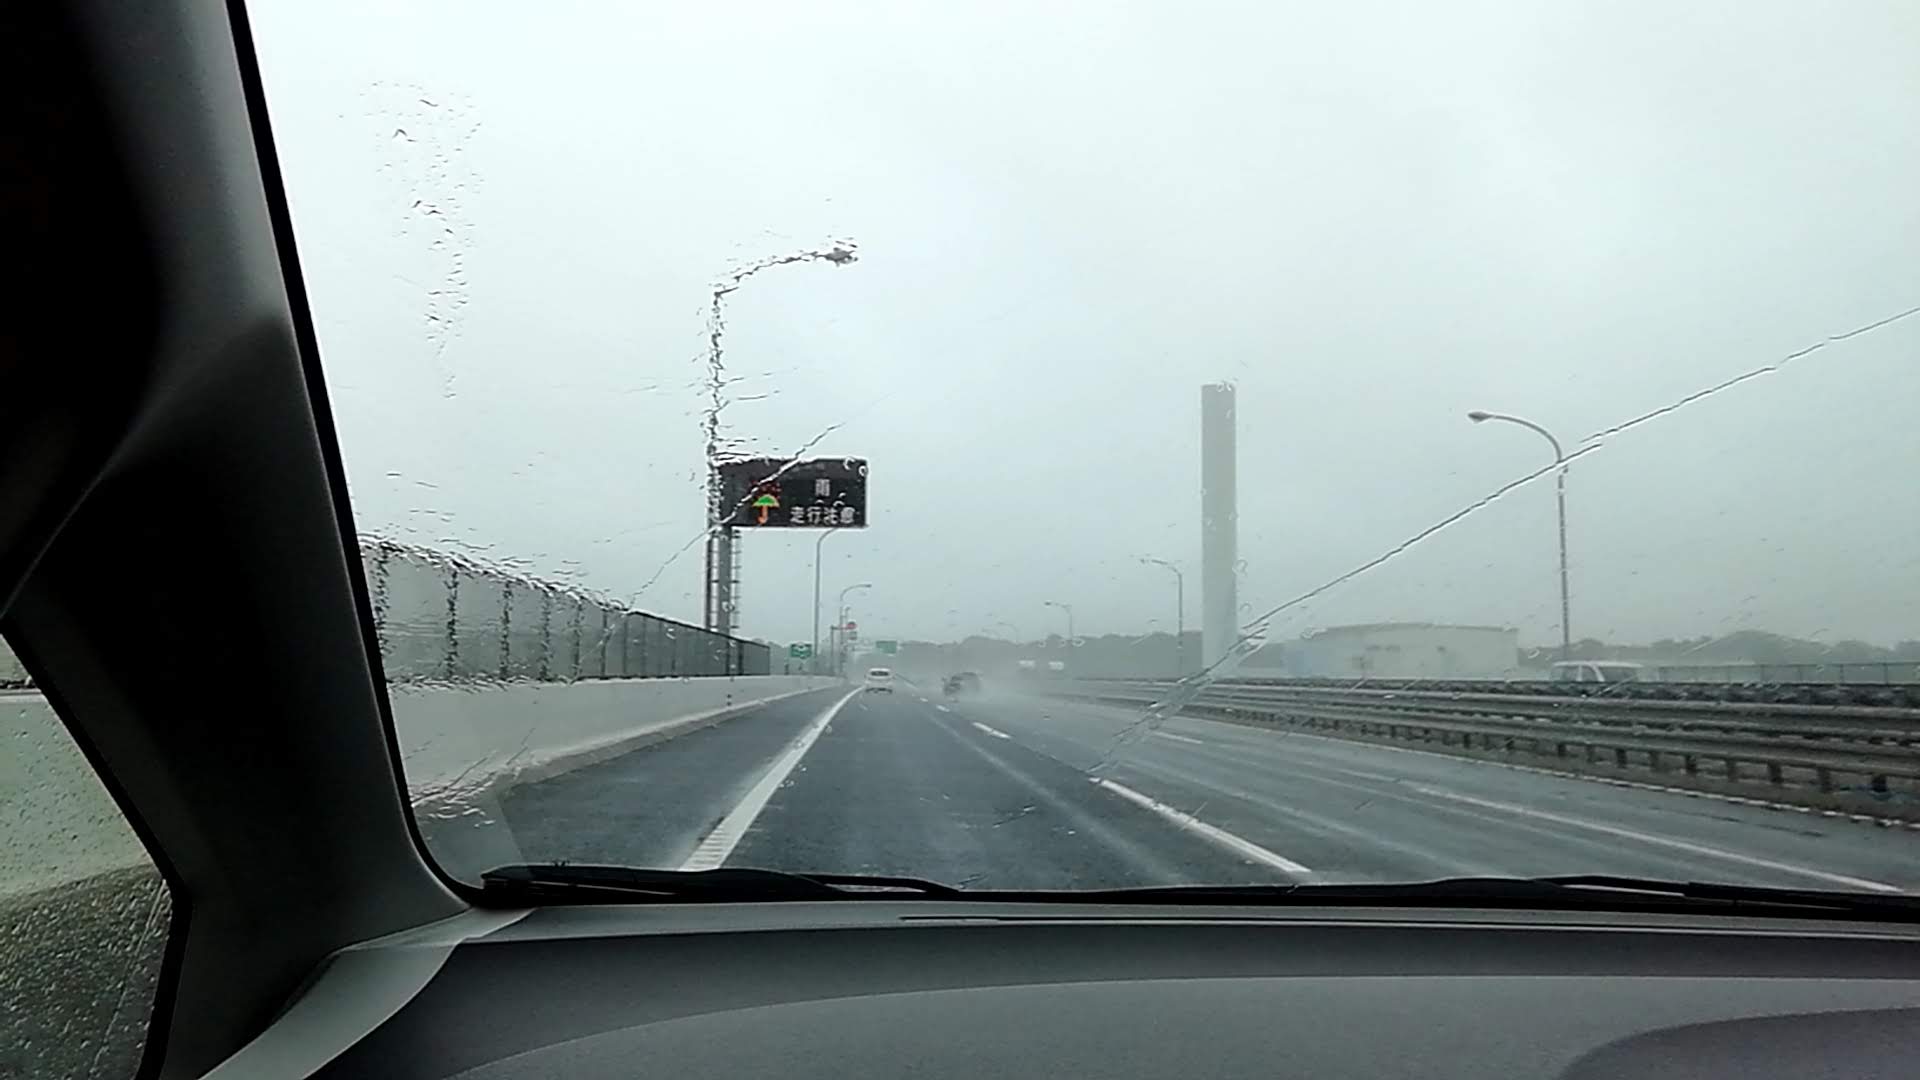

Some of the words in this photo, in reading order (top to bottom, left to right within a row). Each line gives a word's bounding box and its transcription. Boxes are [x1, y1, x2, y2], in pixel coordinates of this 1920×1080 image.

[815, 478, 830, 497] 雨
[790, 506, 855, 524] 走行注意
